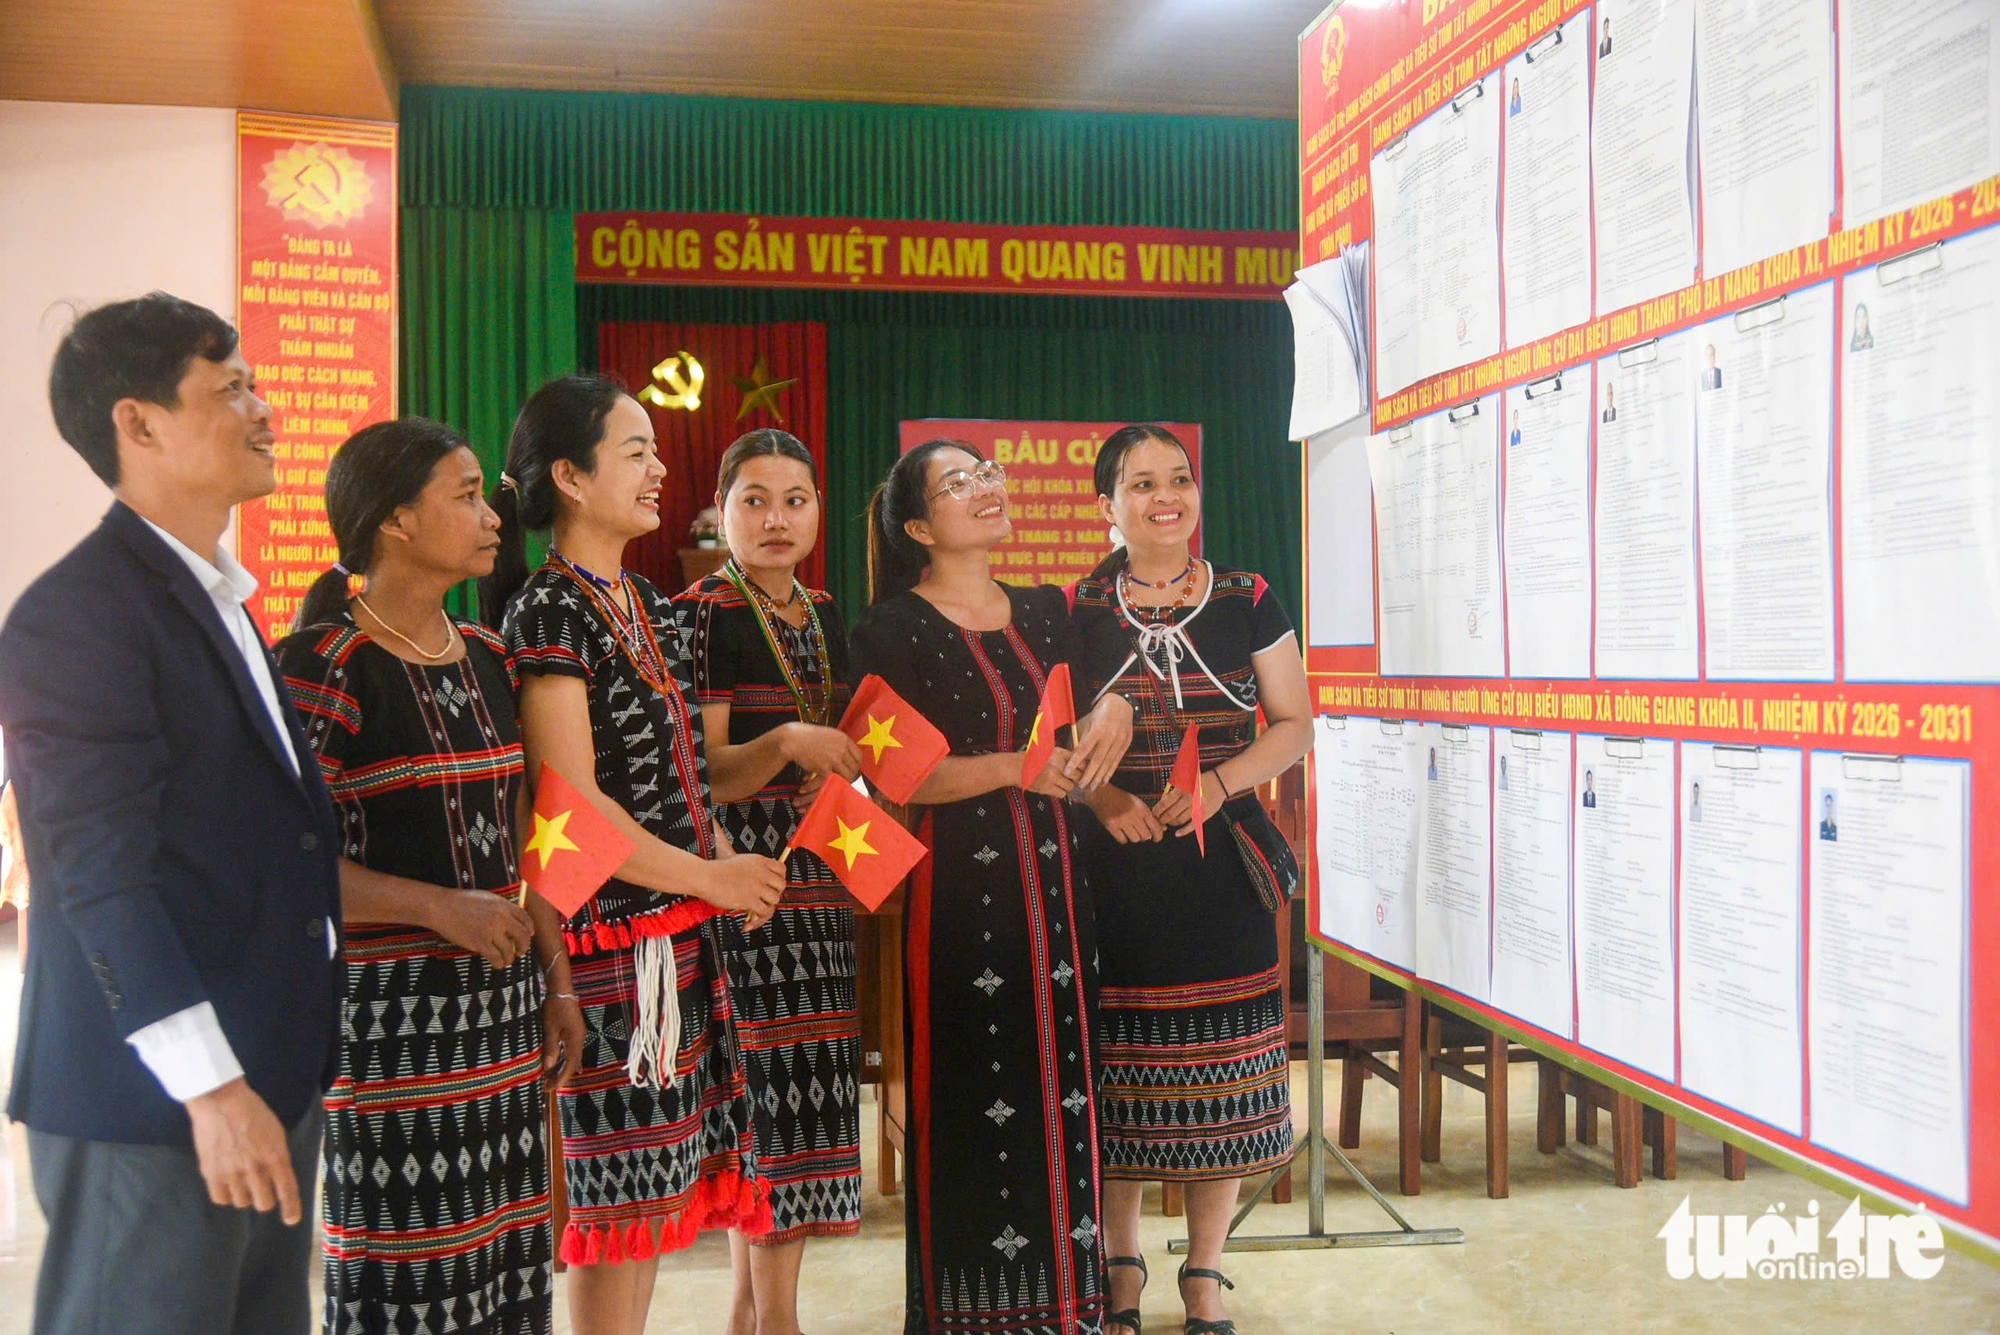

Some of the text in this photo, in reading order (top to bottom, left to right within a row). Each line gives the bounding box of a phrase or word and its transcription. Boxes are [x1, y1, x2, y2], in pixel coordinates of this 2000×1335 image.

[1374, 115, 1391, 149] DANH
[1392, 104, 1412, 134] SÁCH
[1413, 89, 1423, 119] VÀ
[1424, 72, 1441, 110] TIỂU
[1442, 62, 1454, 98] SỬ
[1455, 55, 1474, 89] TÓM
[1476, 37, 1492, 73] TẮT
[1494, 22, 1527, 63] NHỮNG
[323, 239, 336, 256] TA
[338, 237, 353, 257] LÀ
[592, 217, 1299, 285] CỘNG SẢN VIỆT NAM QUANG VINH MU
[251, 258, 277, 281] MỘT
[279, 258, 311, 281] ĐẢNG
[313, 260, 339, 282] CẦM
[268, 283, 300, 305] ĐẢNG
[303, 286, 329, 307] VIÊN
[331, 288, 346, 308] VÀ
[348, 290, 372, 310] CÁN
[374, 292, 390, 313] BỘ
[1376, 400, 1391, 425] DANH
[1392, 392, 1409, 420] SÁCH
[1409, 386, 1418, 413] VÀ
[1419, 378, 1433, 410] TIỂU
[1433, 373, 1443, 405] SỬ
[1443, 372, 1459, 401] TÓM
[1461, 365, 1473, 395] TẮT
[1475, 358, 1502, 390] NHỮNG
[1504, 344, 1531, 380] NGƯỜI
[1533, 340, 1552, 371] ỨNG
[1568, 327, 1584, 363] ĐẠI
[1610, 308, 1638, 345] HĐND
[1909, 194, 1954, 239] 2026
[279, 310, 306, 331] PHẢI
[310, 314, 337, 335] THẬT
[281, 362, 305, 382] ĐỨC
[307, 364, 338, 384] CÁCH
[265, 388, 293, 411] THẬT
[340, 391, 369, 412] KIỆM
[283, 414, 311, 434] LIÊM
[272, 439, 291, 459] CHÍ
[294, 440, 325, 460] CÔNG
[994, 430, 1059, 465] BẦU
[266, 491, 326, 512] THẬT TRON
[1074, 501, 1106, 522] NHIỆ
[270, 514, 331, 537] PHẢI XỨNG
[1064, 530, 1073, 544] 3
[260, 541, 340, 562] LÀ NGƯỜI LÃN
[270, 567, 322, 588] LÀ NGƯỜ
[263, 593, 291, 615] THẬT
[1319, 685, 1334, 706] DANH
[1335, 682, 1351, 707] SÁCH
[1353, 682, 1361, 707] VÀ
[1362, 678, 1377, 708] TIỂU
[1378, 680, 1388, 709] SỬ
[1389, 683, 1404, 709] TÓM
[1406, 680, 1420, 710] TẮT
[1421, 685, 1450, 712] NHỮNG
[1452, 685, 1479, 714] NGƯỜI
[1481, 685, 1500, 715] ỨNG
[1501, 683, 1515, 716] CỬ
[1516, 691, 1533, 723] ĐẠI
[1535, 682, 1559, 719] BIỂU
[1561, 692, 1592, 721] HĐND
[1595, 689, 1612, 722] XÃ
[1614, 689, 1650, 724] ĐÔNG
[1653, 696, 1695, 727] GIANG
[1699, 691, 1739, 729] KHÓA
[1743, 699, 1759, 733] II,
[1762, 693, 1819, 740] NHIỆM
[1823, 693, 1847, 735] KỲ
[1851, 701, 1900, 738] 2026
[1920, 703, 1972, 742] 2031
